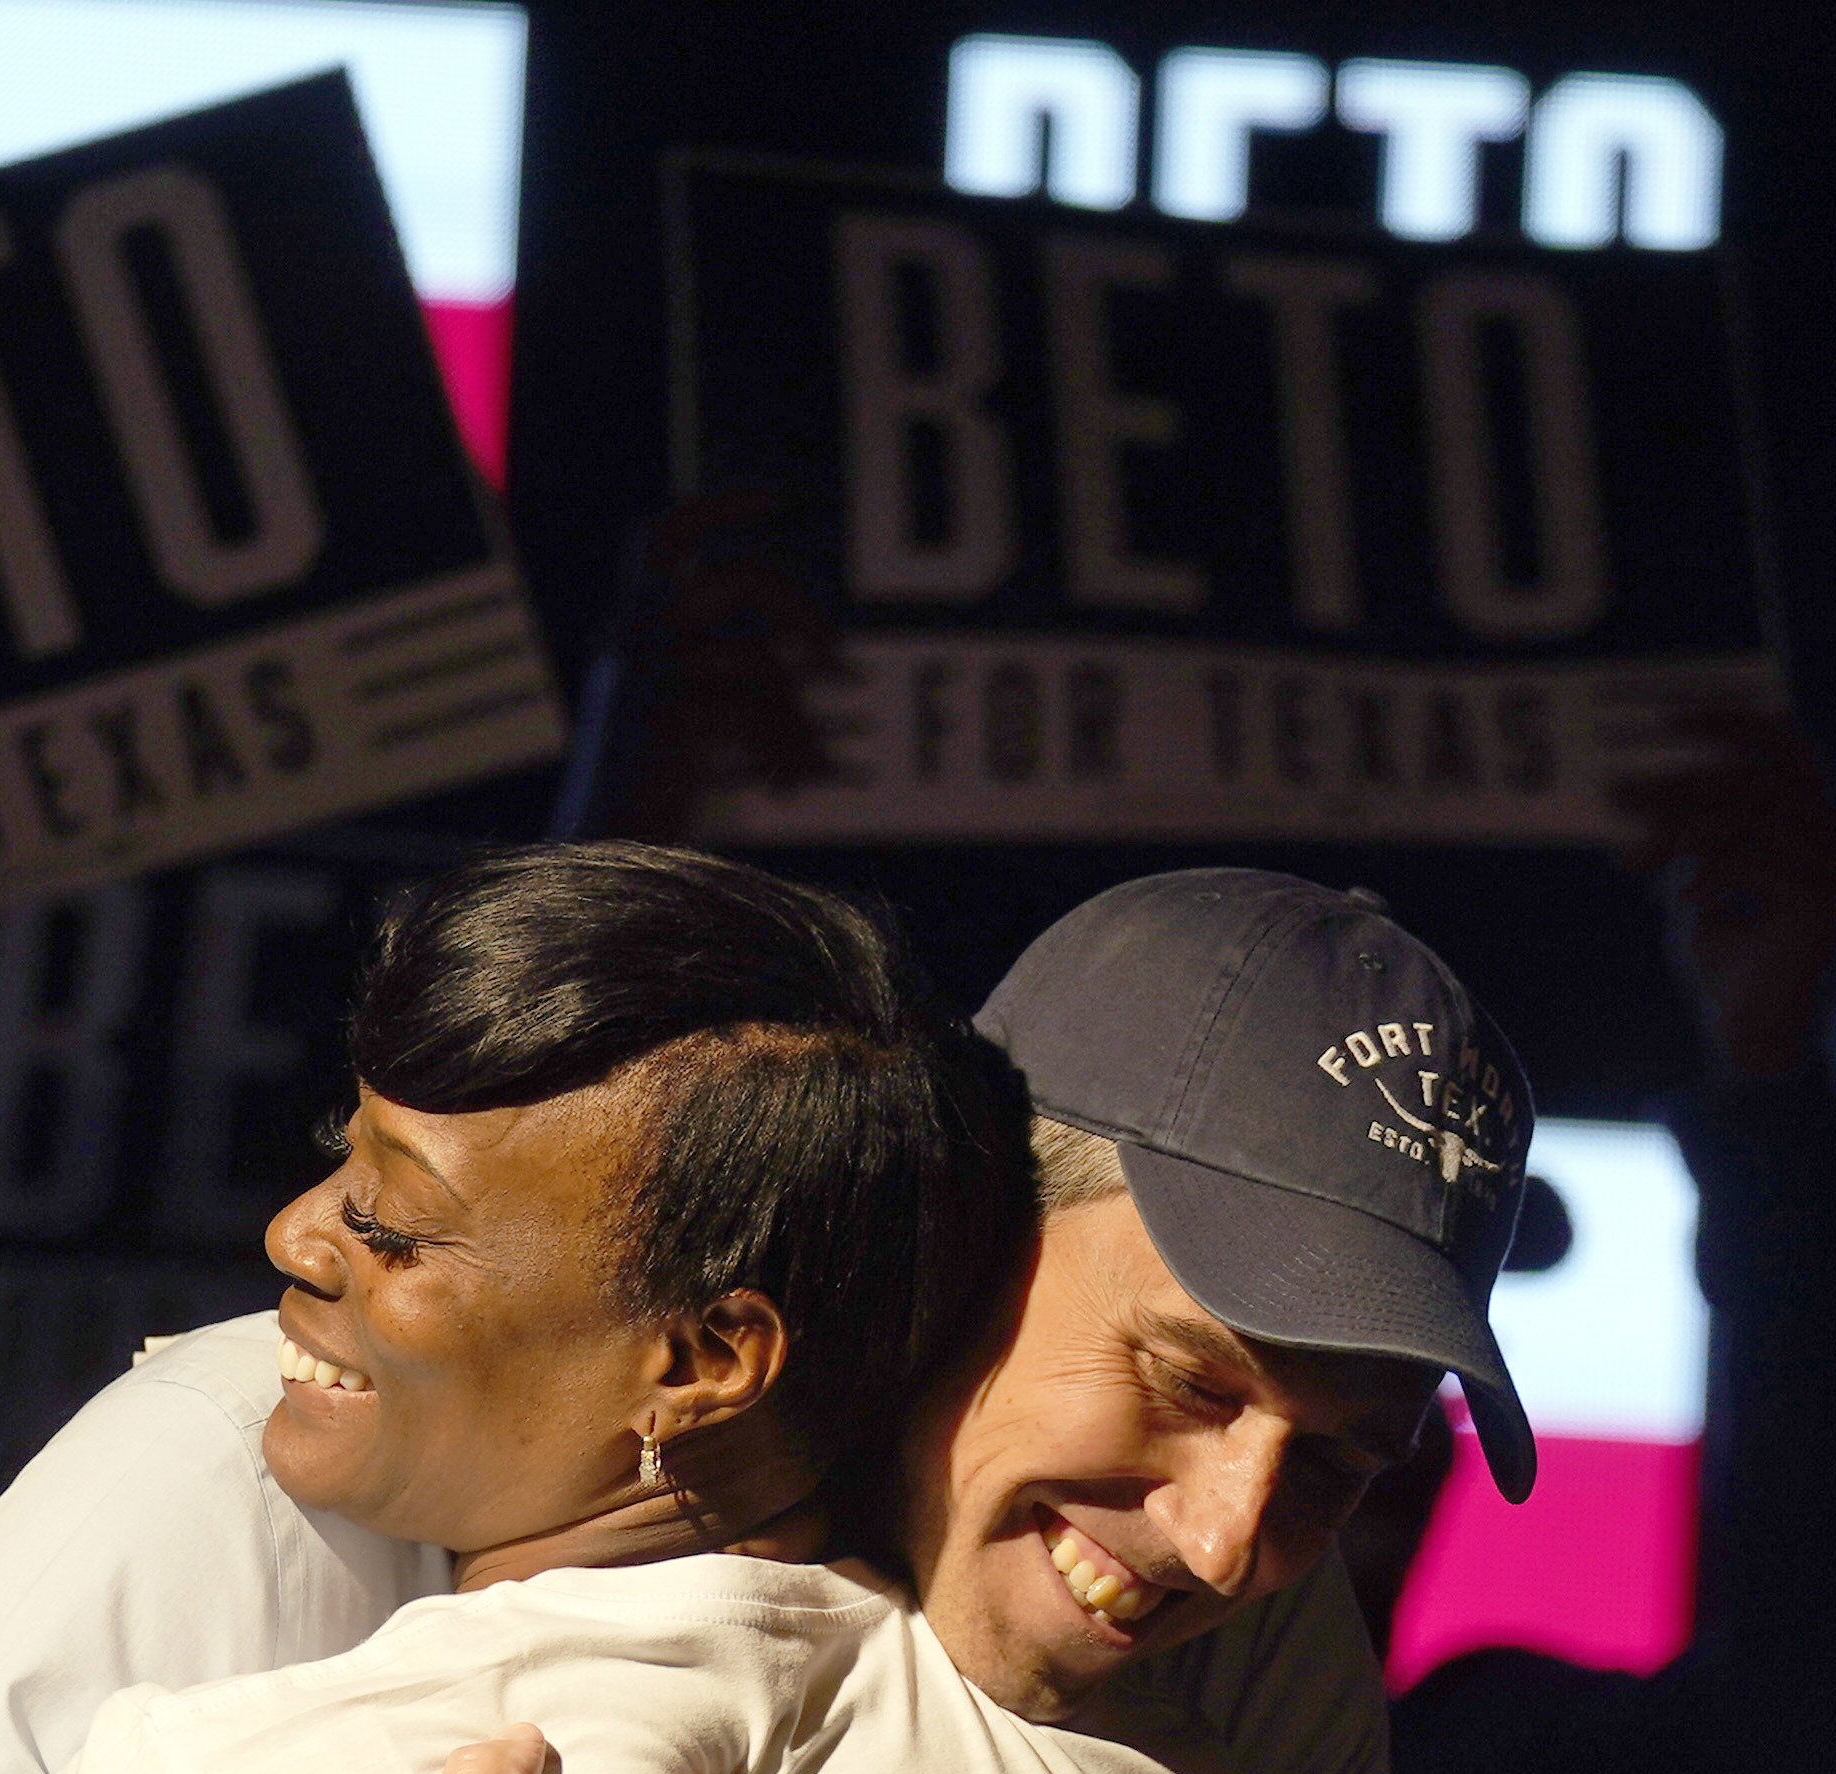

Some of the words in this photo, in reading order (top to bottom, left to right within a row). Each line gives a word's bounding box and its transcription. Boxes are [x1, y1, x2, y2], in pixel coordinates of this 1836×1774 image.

[829, 206, 1612, 643] BETO
[907, 656, 1125, 785] FOR
[1203, 660, 1556, 798] TEXAS
[1315, 1021, 1434, 1087] FORT
